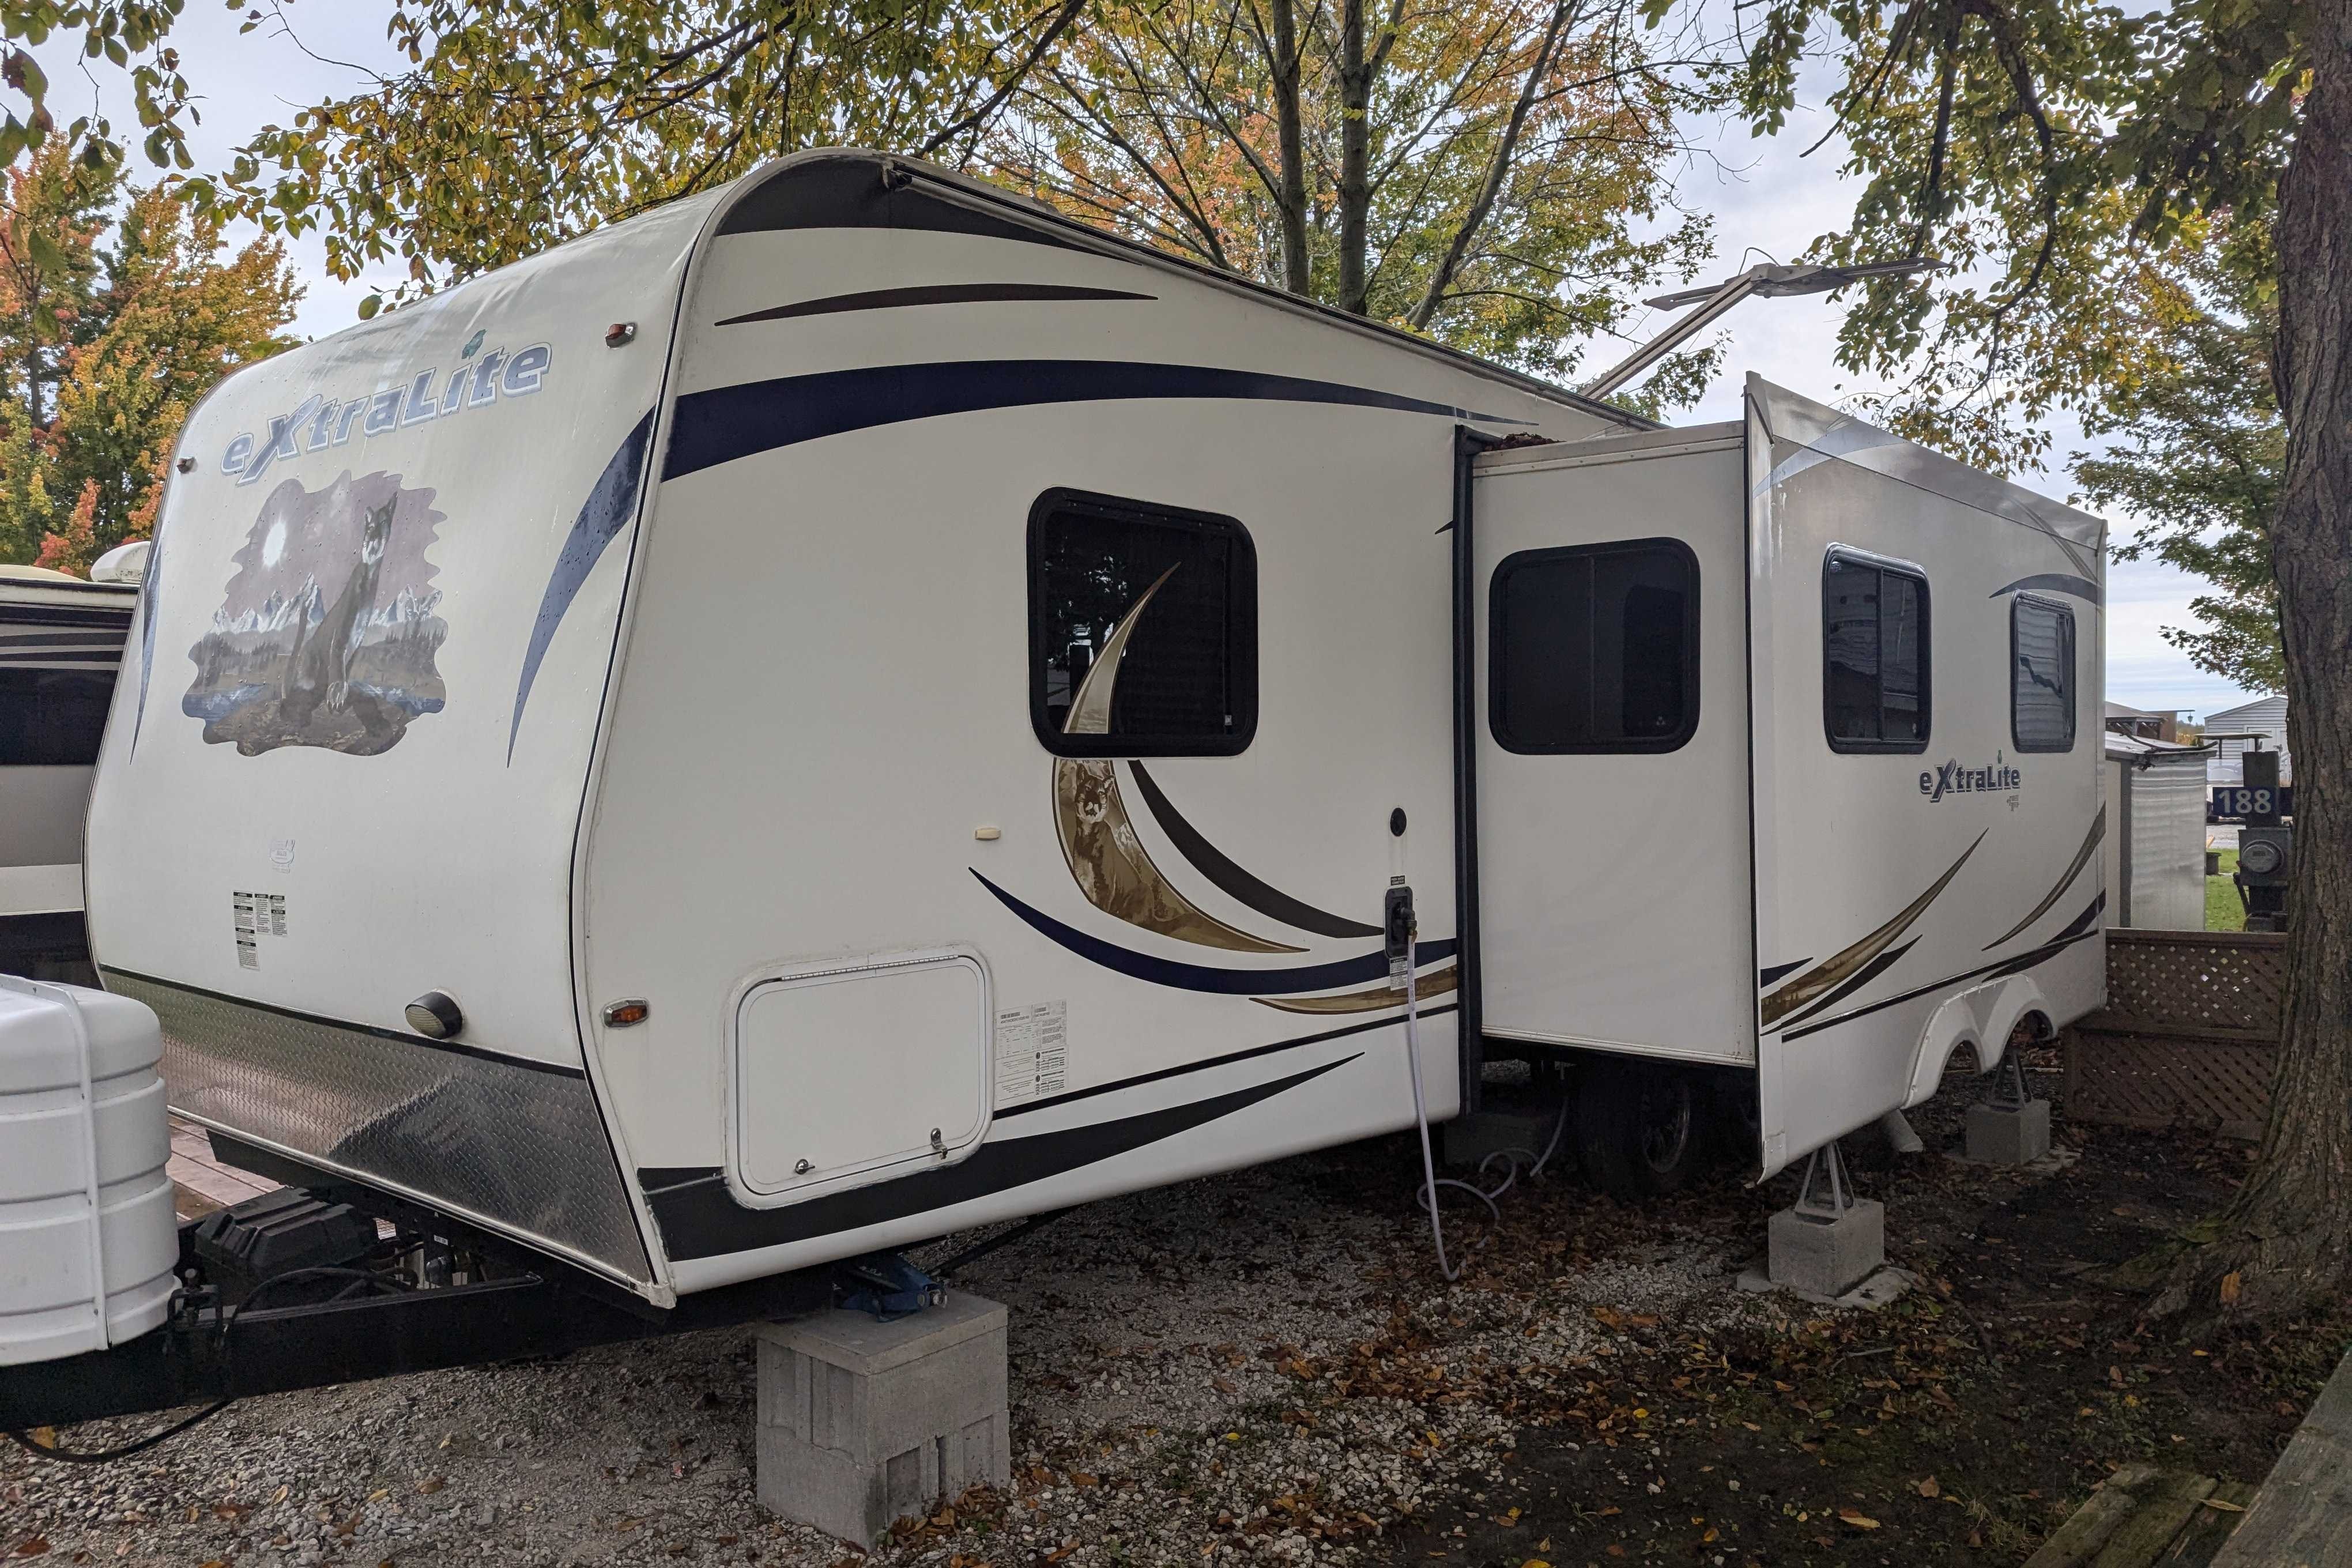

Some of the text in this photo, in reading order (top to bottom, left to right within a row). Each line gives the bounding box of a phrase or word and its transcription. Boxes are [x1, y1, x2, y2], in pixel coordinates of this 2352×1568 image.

[220, 330, 552, 487] eXtraLite
[1920, 751, 2021, 804] eXtraLite
[2219, 790, 2271, 813] 188
